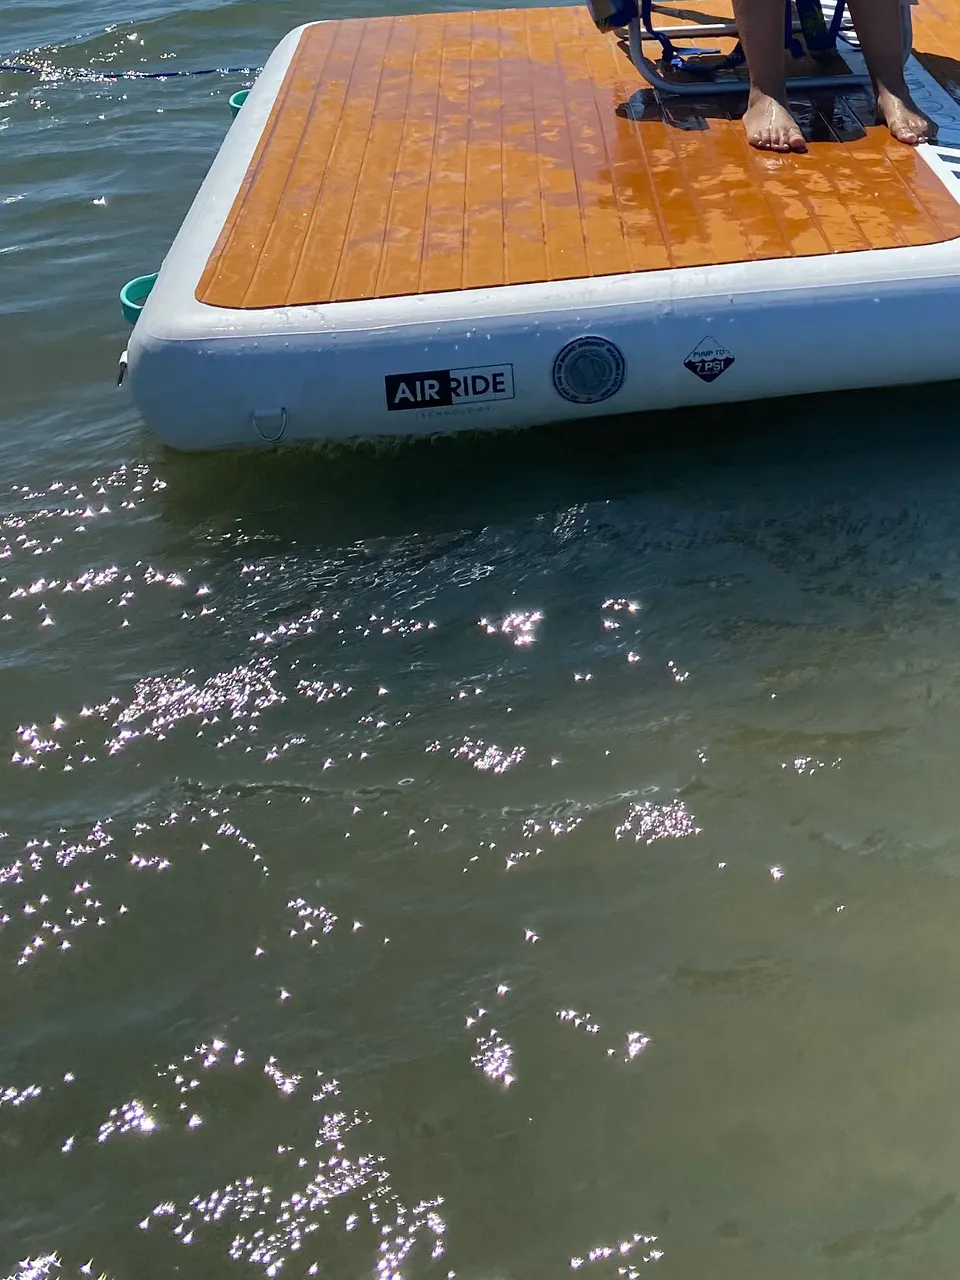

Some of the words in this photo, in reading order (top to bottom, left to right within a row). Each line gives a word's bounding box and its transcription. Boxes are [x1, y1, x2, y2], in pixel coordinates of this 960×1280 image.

[692, 350, 714, 358] PUMP
[695, 362, 703, 373] 7
[704, 360, 725, 372] PSI
[393, 379, 441, 404] AIR
[450, 372, 506, 398] RIDE
